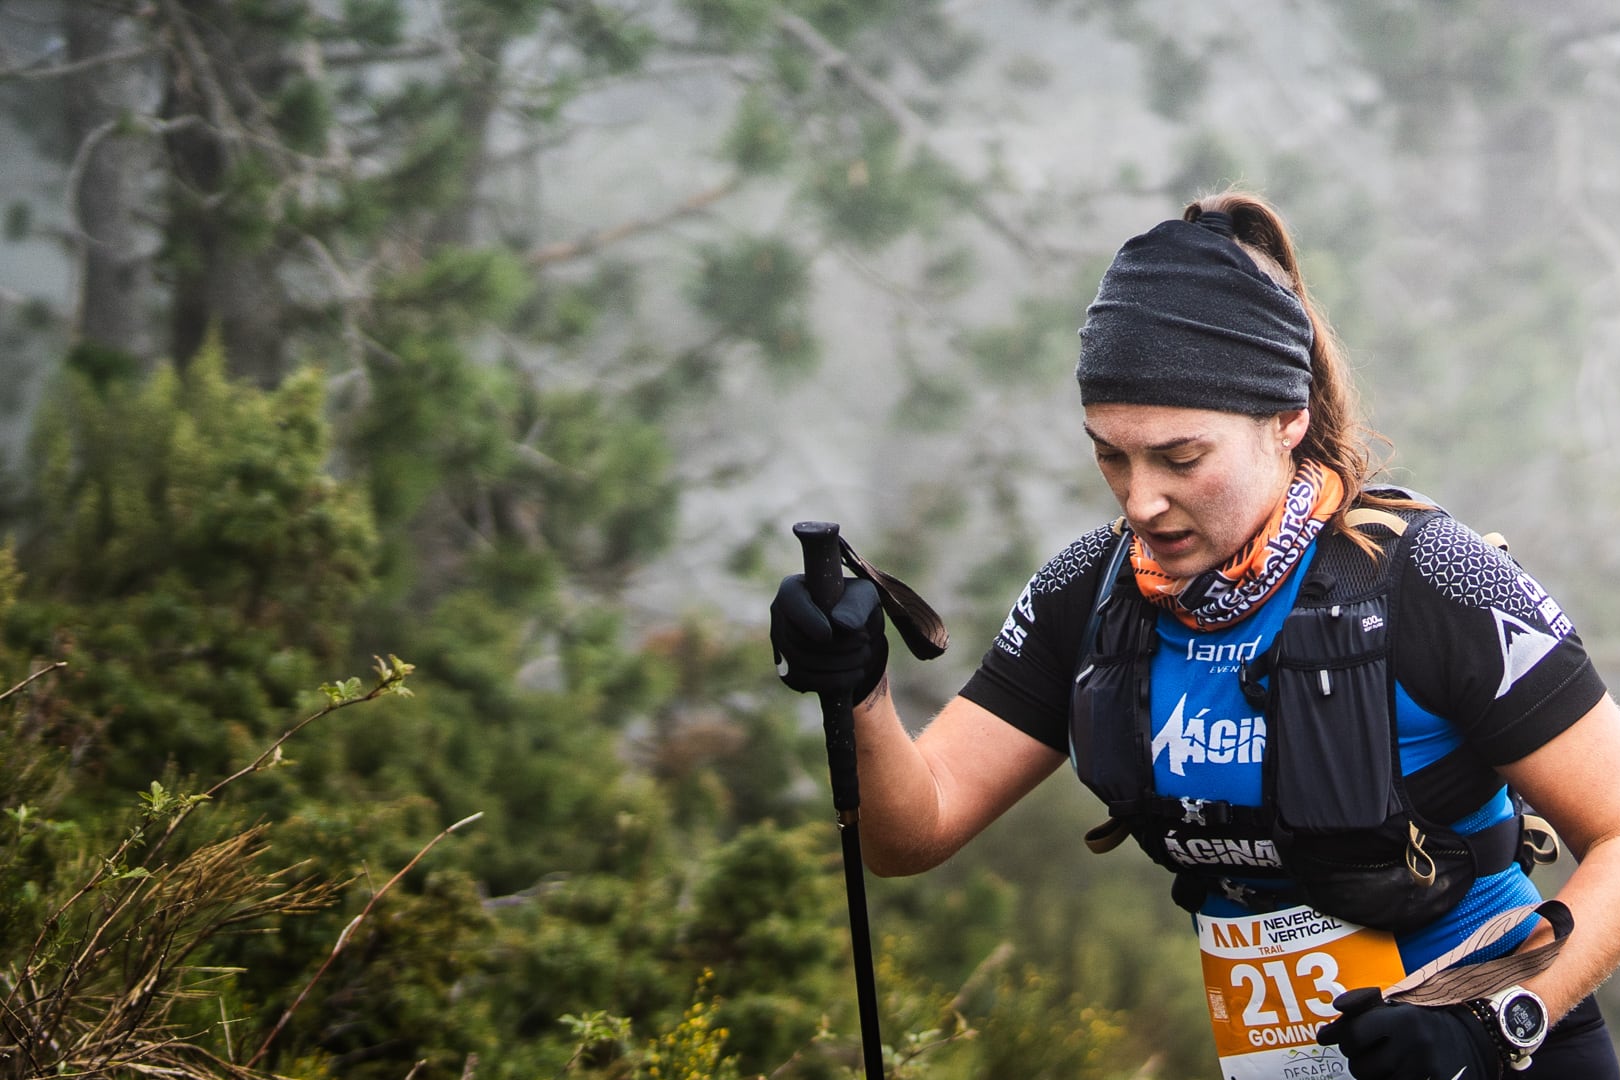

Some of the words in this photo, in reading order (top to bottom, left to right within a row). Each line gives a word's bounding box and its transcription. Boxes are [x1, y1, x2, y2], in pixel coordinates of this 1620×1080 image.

[1186, 634, 1262, 662] land
[1268, 918, 1343, 943] VERTICAL
[1258, 944, 1285, 956] TRAIL
[1230, 952, 1347, 1027] 213
[1248, 1018, 1336, 1047] GOMIN
